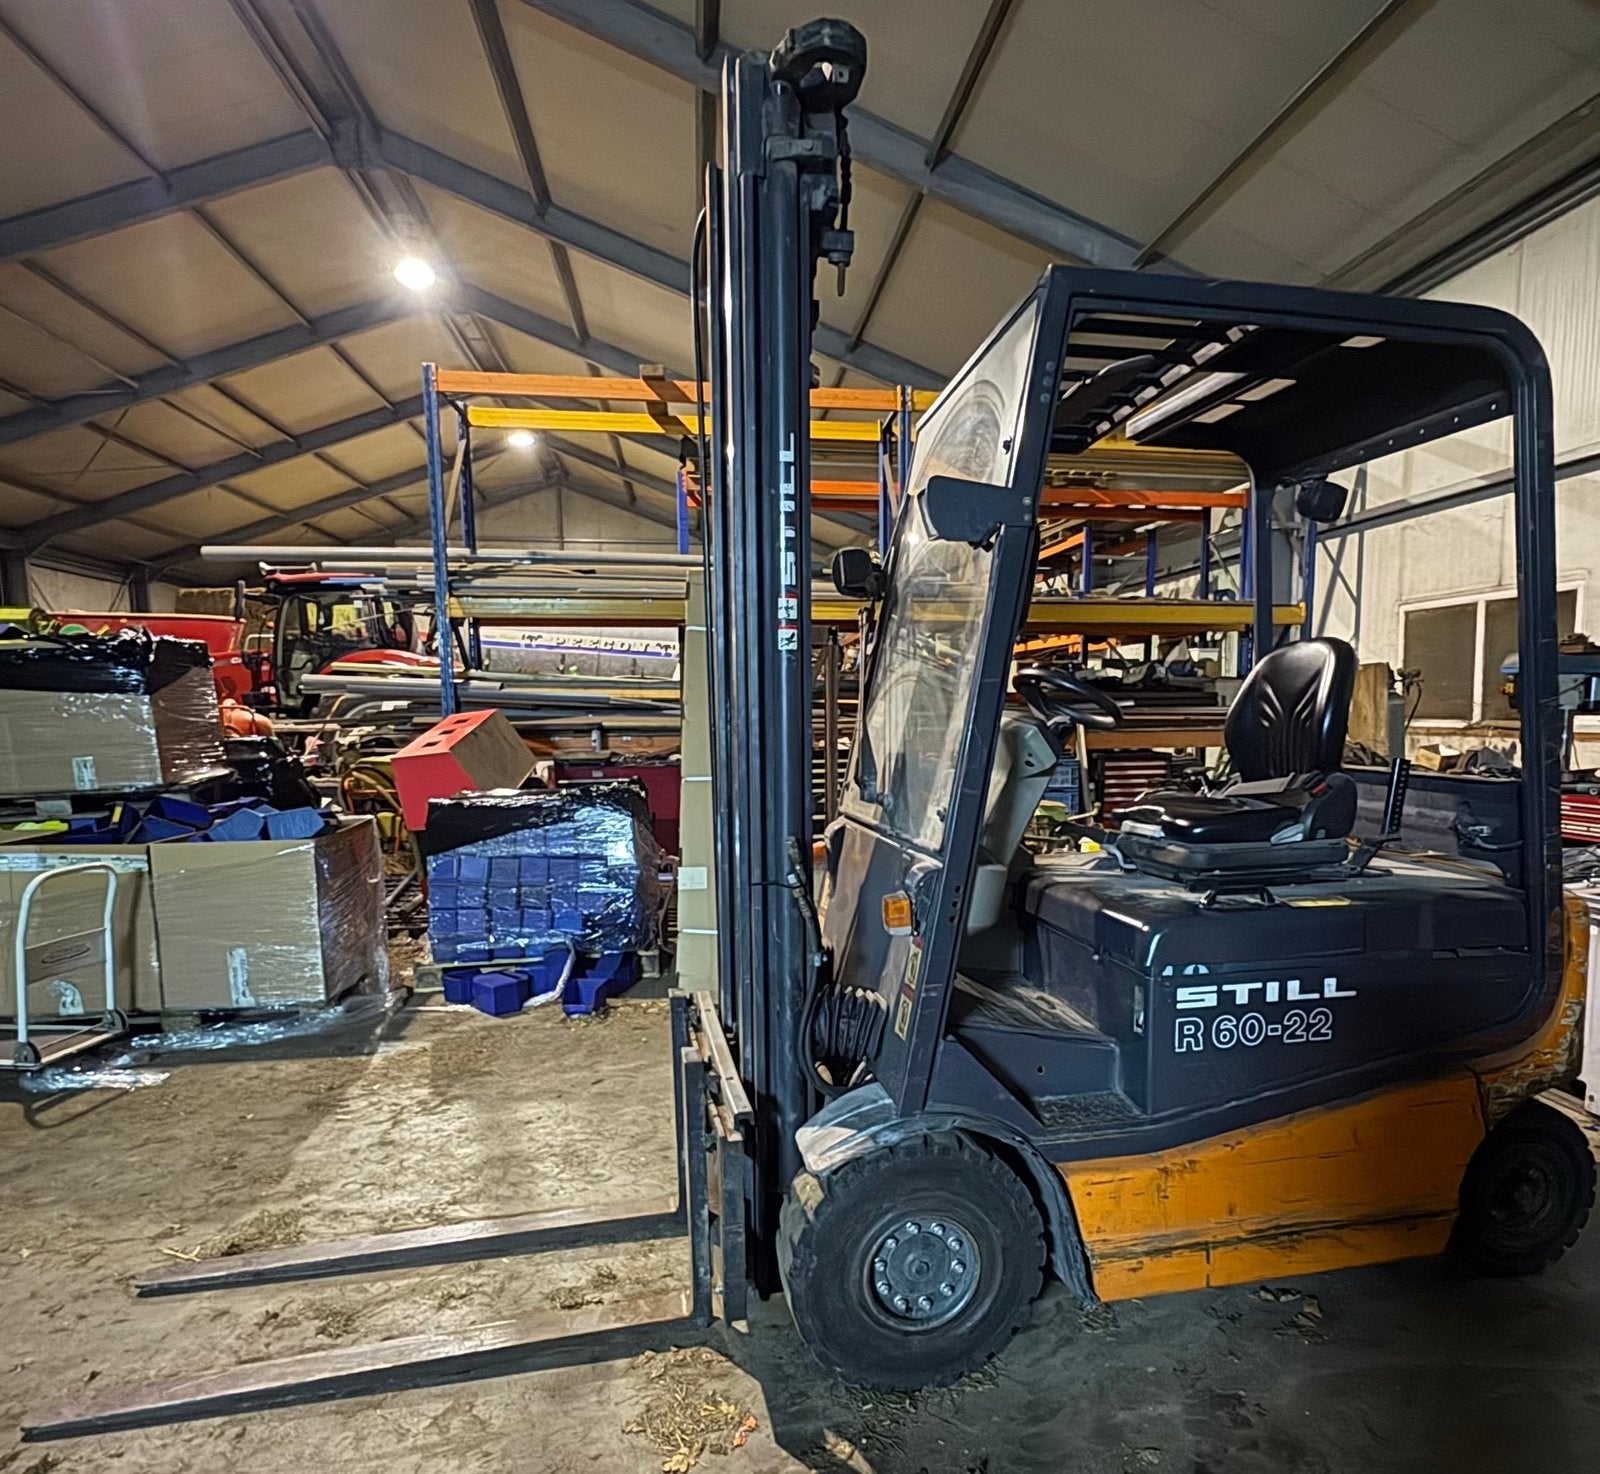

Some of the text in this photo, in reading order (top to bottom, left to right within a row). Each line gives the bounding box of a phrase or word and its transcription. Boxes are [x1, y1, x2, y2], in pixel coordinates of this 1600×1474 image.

[778, 432, 796, 586] STILL
[1175, 977, 1358, 1010] STILL
[1174, 1007, 1333, 1053] R 60-22
